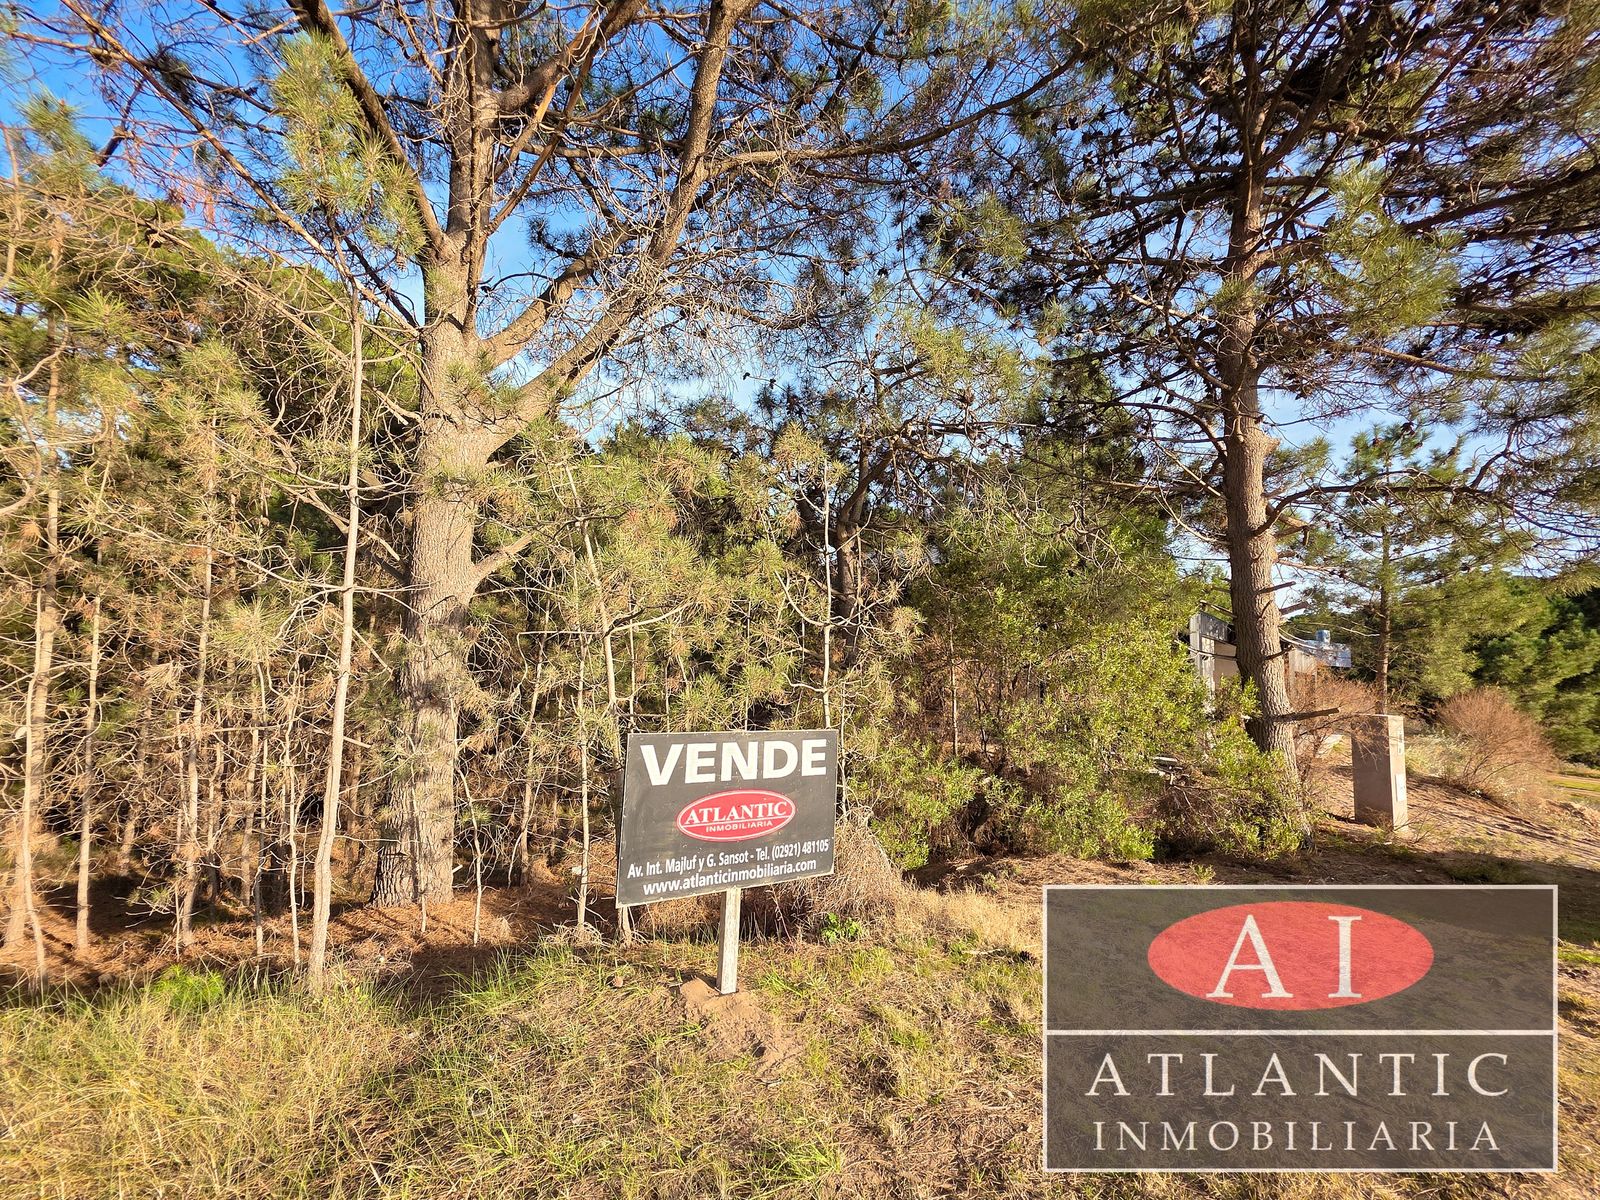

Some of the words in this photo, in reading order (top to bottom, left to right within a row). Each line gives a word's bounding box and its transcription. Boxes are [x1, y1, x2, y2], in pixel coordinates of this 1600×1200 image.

[640, 739, 826, 786] VENDE
[685, 802, 787, 825] ATLANTIC
[706, 820, 773, 832] INMOBILIARIA
[627, 864, 643, 878] Av.
[646, 861, 662, 876] Int.
[665, 855, 697, 875] Majluf
[698, 858, 705, 872] y
[707, 854, 716, 867] G.
[719, 851, 749, 866] Sansot
[756, 847, 770, 861] Tel.
[772, 842, 801, 860] (02921)
[802, 839, 829, 854] 481105
[643, 859, 816, 895] www.atlanticinmobiliaria.com
